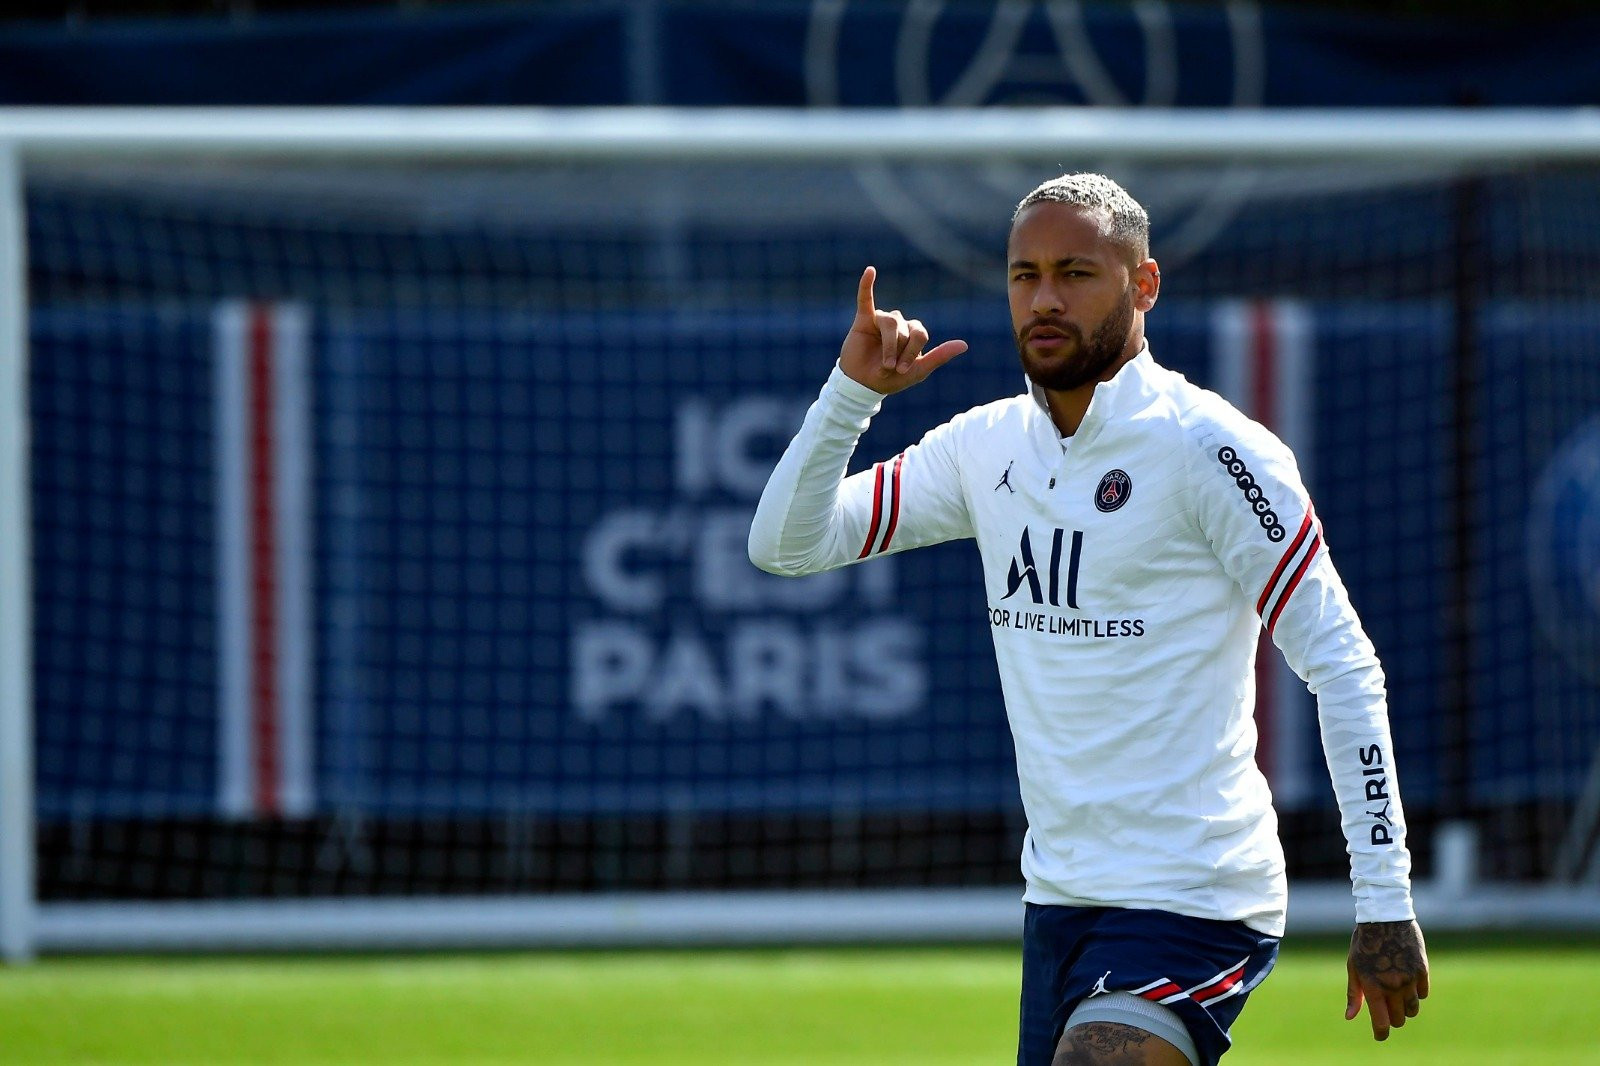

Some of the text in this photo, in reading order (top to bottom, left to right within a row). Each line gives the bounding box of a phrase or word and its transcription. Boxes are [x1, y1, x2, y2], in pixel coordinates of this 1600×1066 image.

[676, 396, 808, 494] IC
[1104, 473, 1126, 484] PARIS
[1218, 446, 1285, 542] ooredoo
[573, 621, 926, 720] PARIS
[1015, 611, 1045, 632] LIVE
[1049, 616, 1145, 637] LIMITLESS
